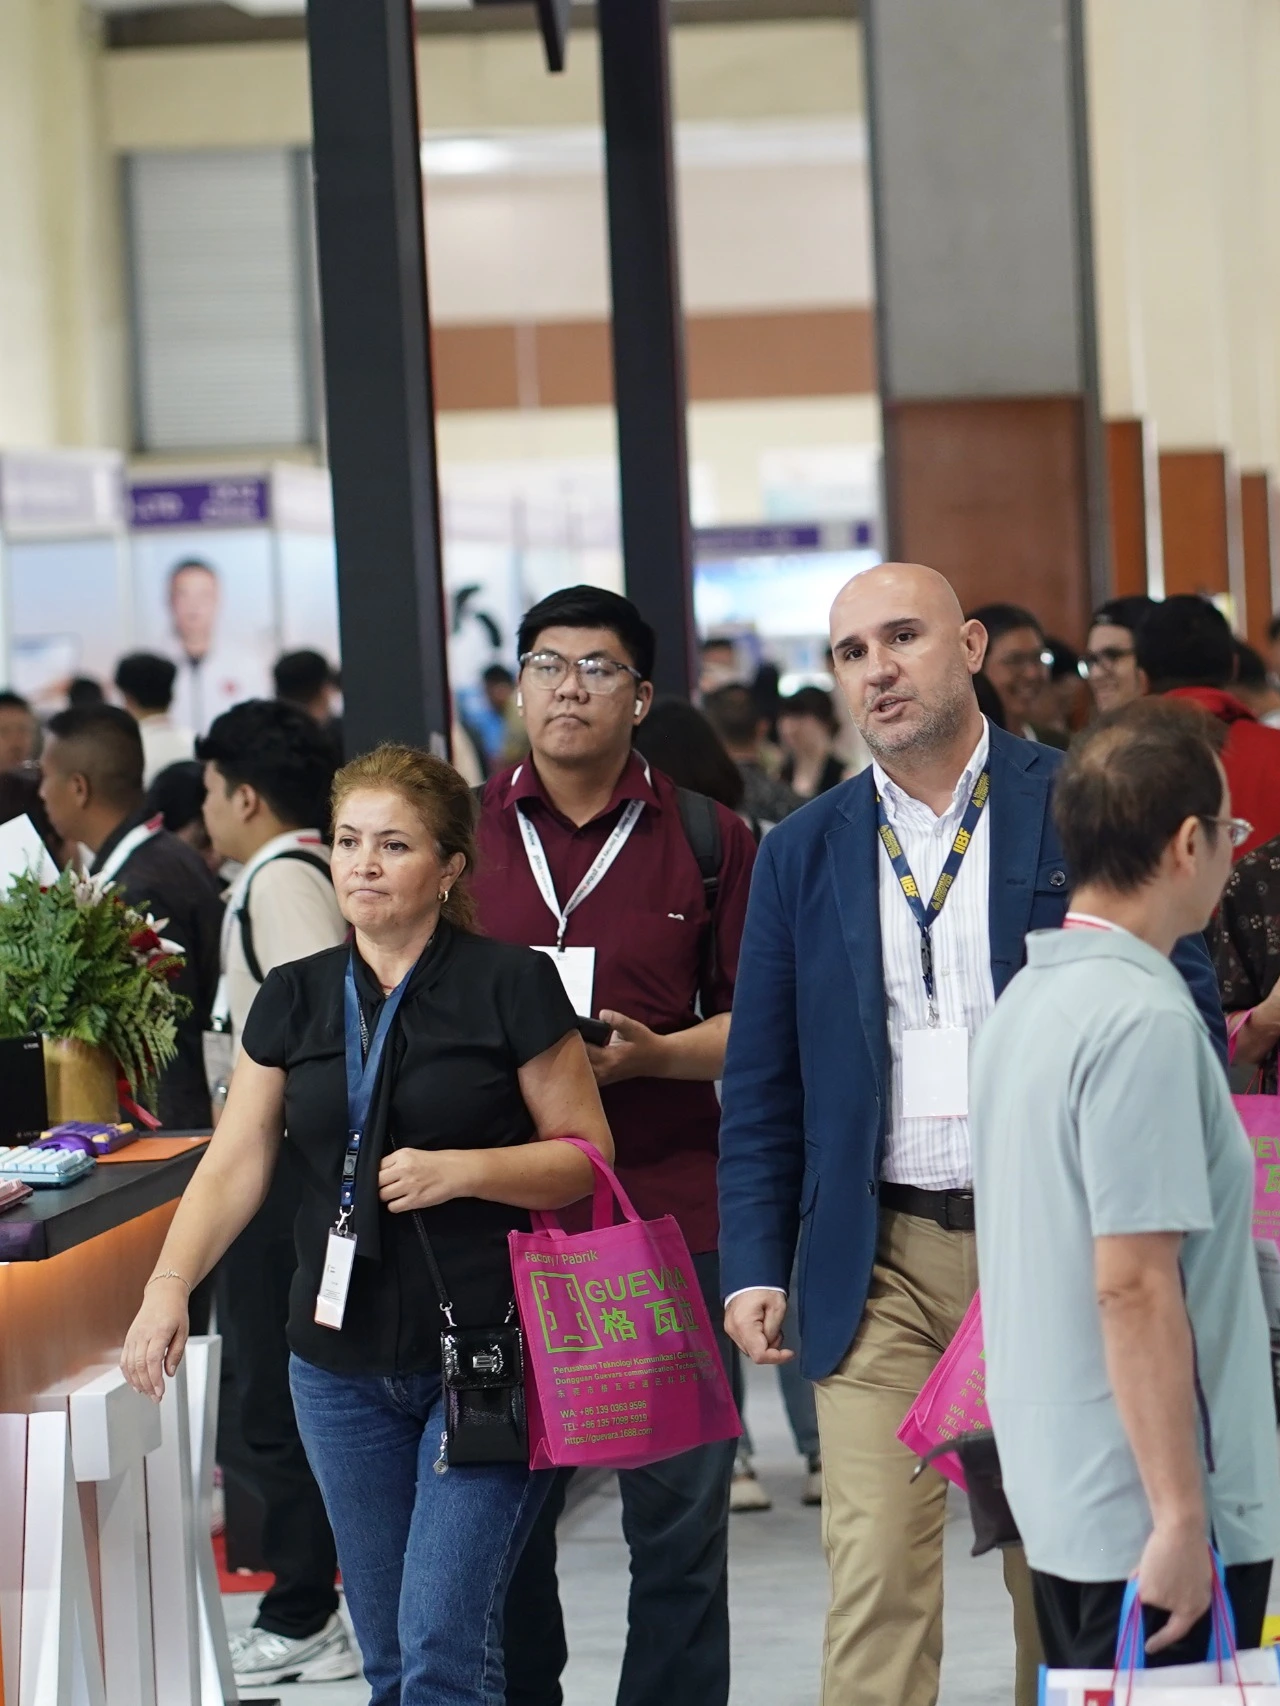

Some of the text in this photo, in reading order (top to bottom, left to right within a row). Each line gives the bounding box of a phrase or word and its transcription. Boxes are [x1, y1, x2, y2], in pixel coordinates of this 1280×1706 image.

[952, 828, 972, 855] IIBF
[900, 875, 920, 898] IIBF
[561, 1250, 598, 1264] Pabrik
[553, 1363, 597, 1375] Perusahaan
[598, 1359, 632, 1371] Teknologi
[633, 1354, 676, 1366] Komunikasi
[555, 1374, 593, 1386] Dongguan
[594, 1370, 623, 1381] Guevara
[623, 1365, 675, 1378] communication
[560, 1410, 577, 1419] WA:
[580, 1407, 594, 1416] +86
[596, 1405, 609, 1414] 139
[563, 1422, 578, 1432] TEL:
[580, 1419, 595, 1429] +86
[597, 1417, 610, 1428] 135
[564, 1426, 653, 1446] https://guevara.1688.com
